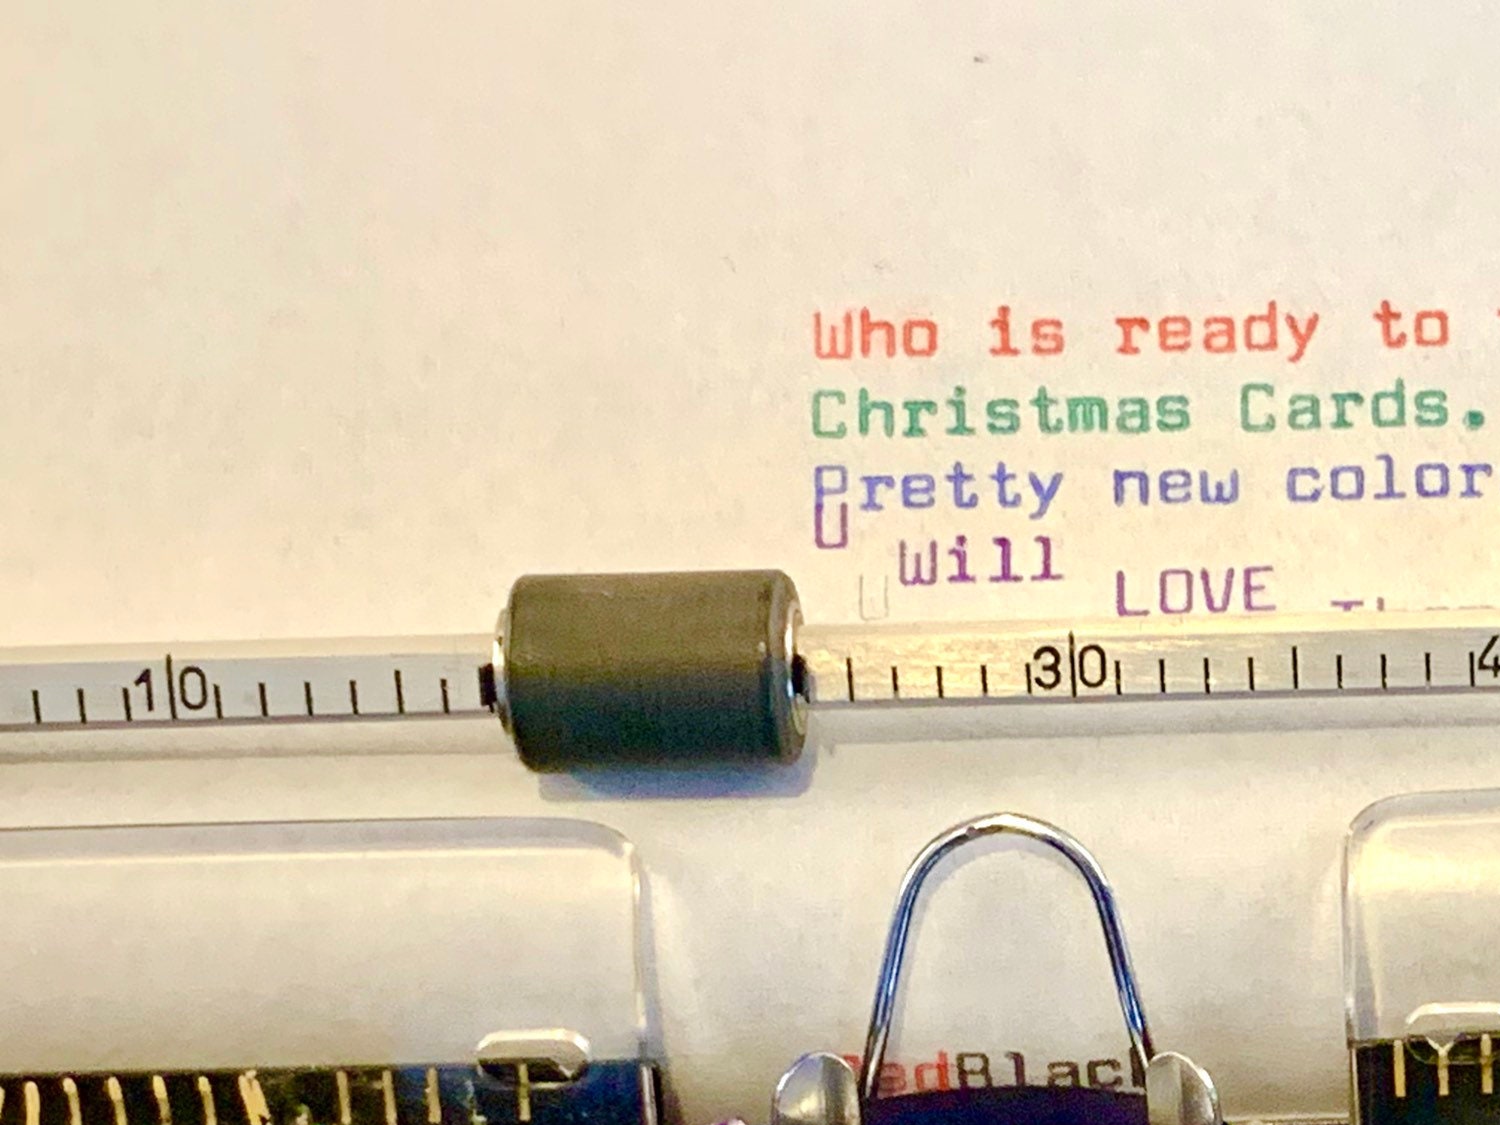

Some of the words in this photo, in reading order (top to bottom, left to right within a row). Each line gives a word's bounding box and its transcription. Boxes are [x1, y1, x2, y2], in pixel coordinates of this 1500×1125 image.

[814, 306, 938, 360] Who
[988, 305, 1066, 357] is
[1115, 301, 1320, 363] ready
[1373, 300, 1450, 349] to
[811, 385, 1192, 439] Christmas
[814, 462, 1064, 520] Pretty
[1112, 467, 1240, 506] new
[899, 534, 1065, 586] Will
[1115, 566, 1277, 618] LOVE
[134, 664, 208, 713] 10
[1032, 644, 1108, 691] 30
[843, 1049, 949, 1097] ed
